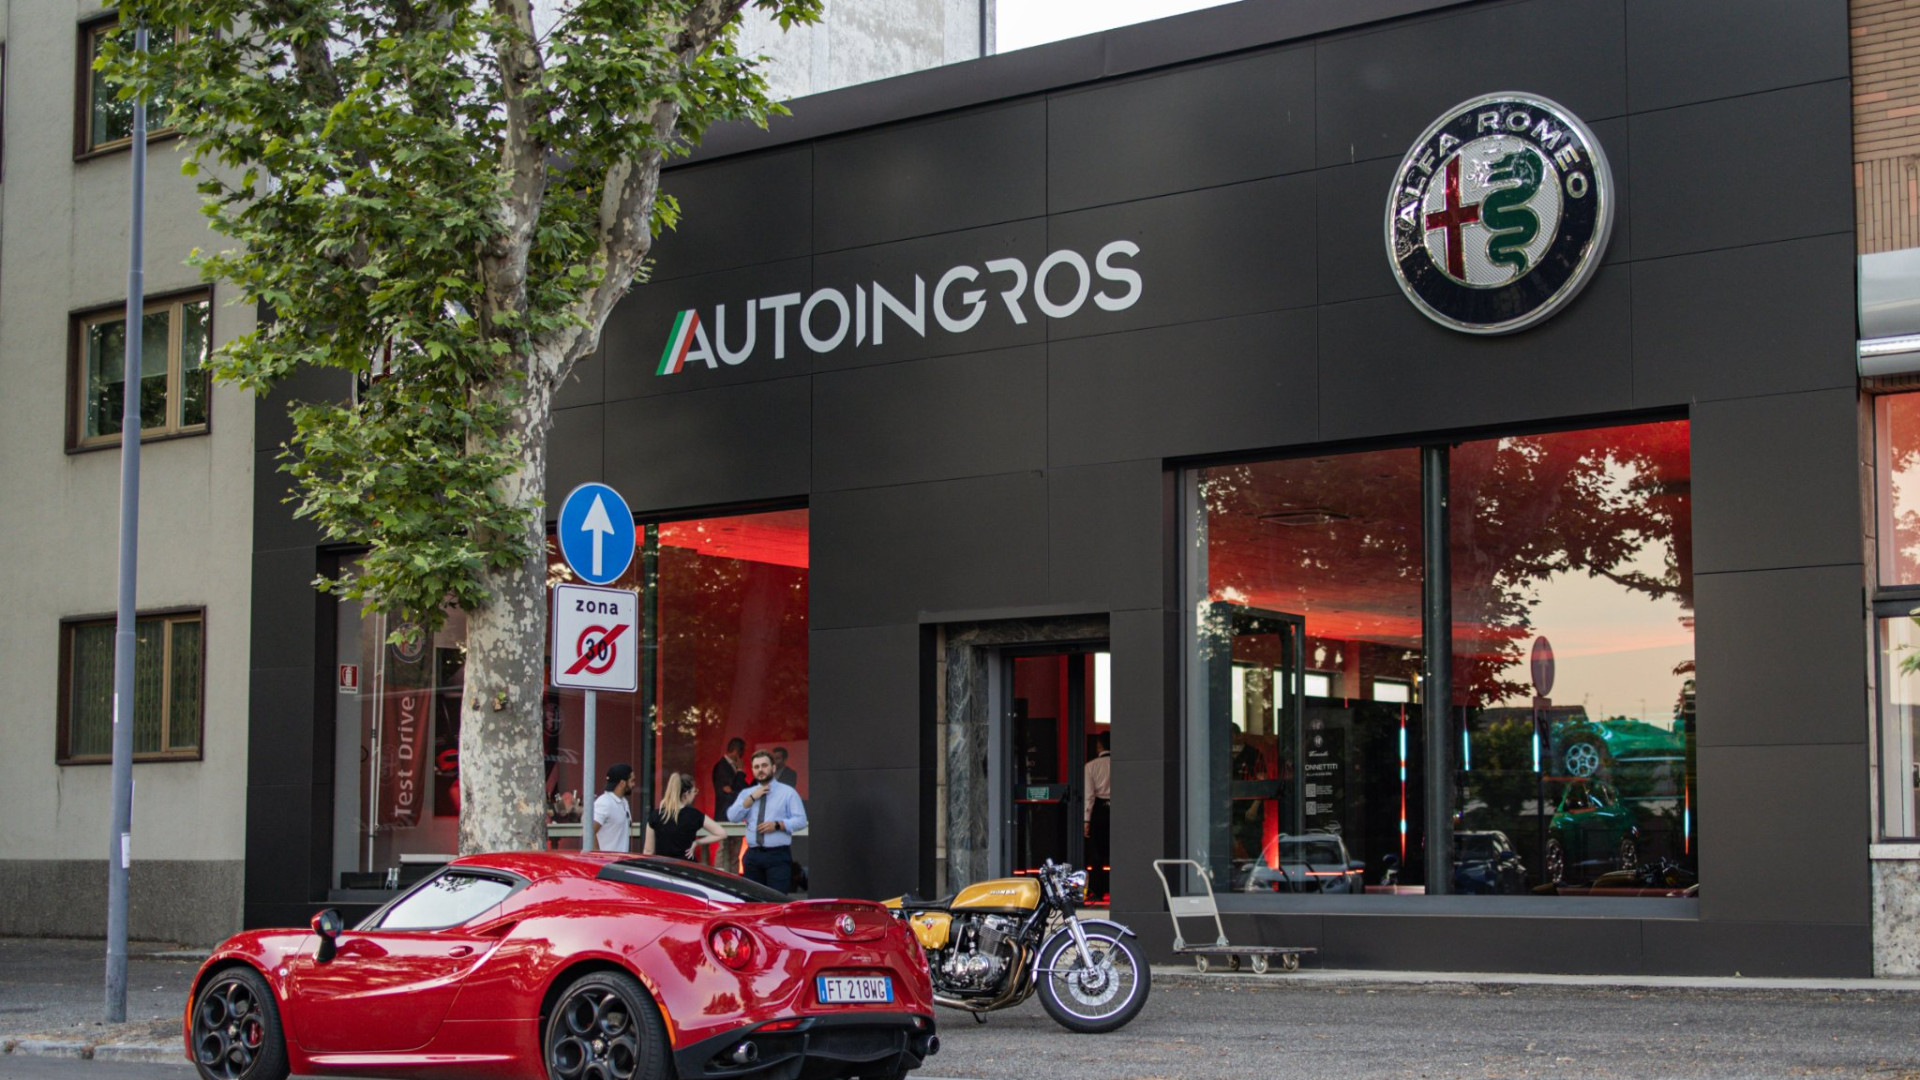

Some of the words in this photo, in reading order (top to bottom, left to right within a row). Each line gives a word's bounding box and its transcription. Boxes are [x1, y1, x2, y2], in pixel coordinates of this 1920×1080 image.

[1401, 133, 1461, 226] ALFA
[1477, 111, 1588, 198] ROMEO
[655, 240, 1143, 376] AUTOINGROS
[576, 599, 619, 615] zona
[585, 638, 608, 661] 30
[398, 695, 416, 760] Drive
[394, 770, 414, 818] Test
[827, 980, 842, 1000] FT
[847, 979, 886, 999] 218WG
